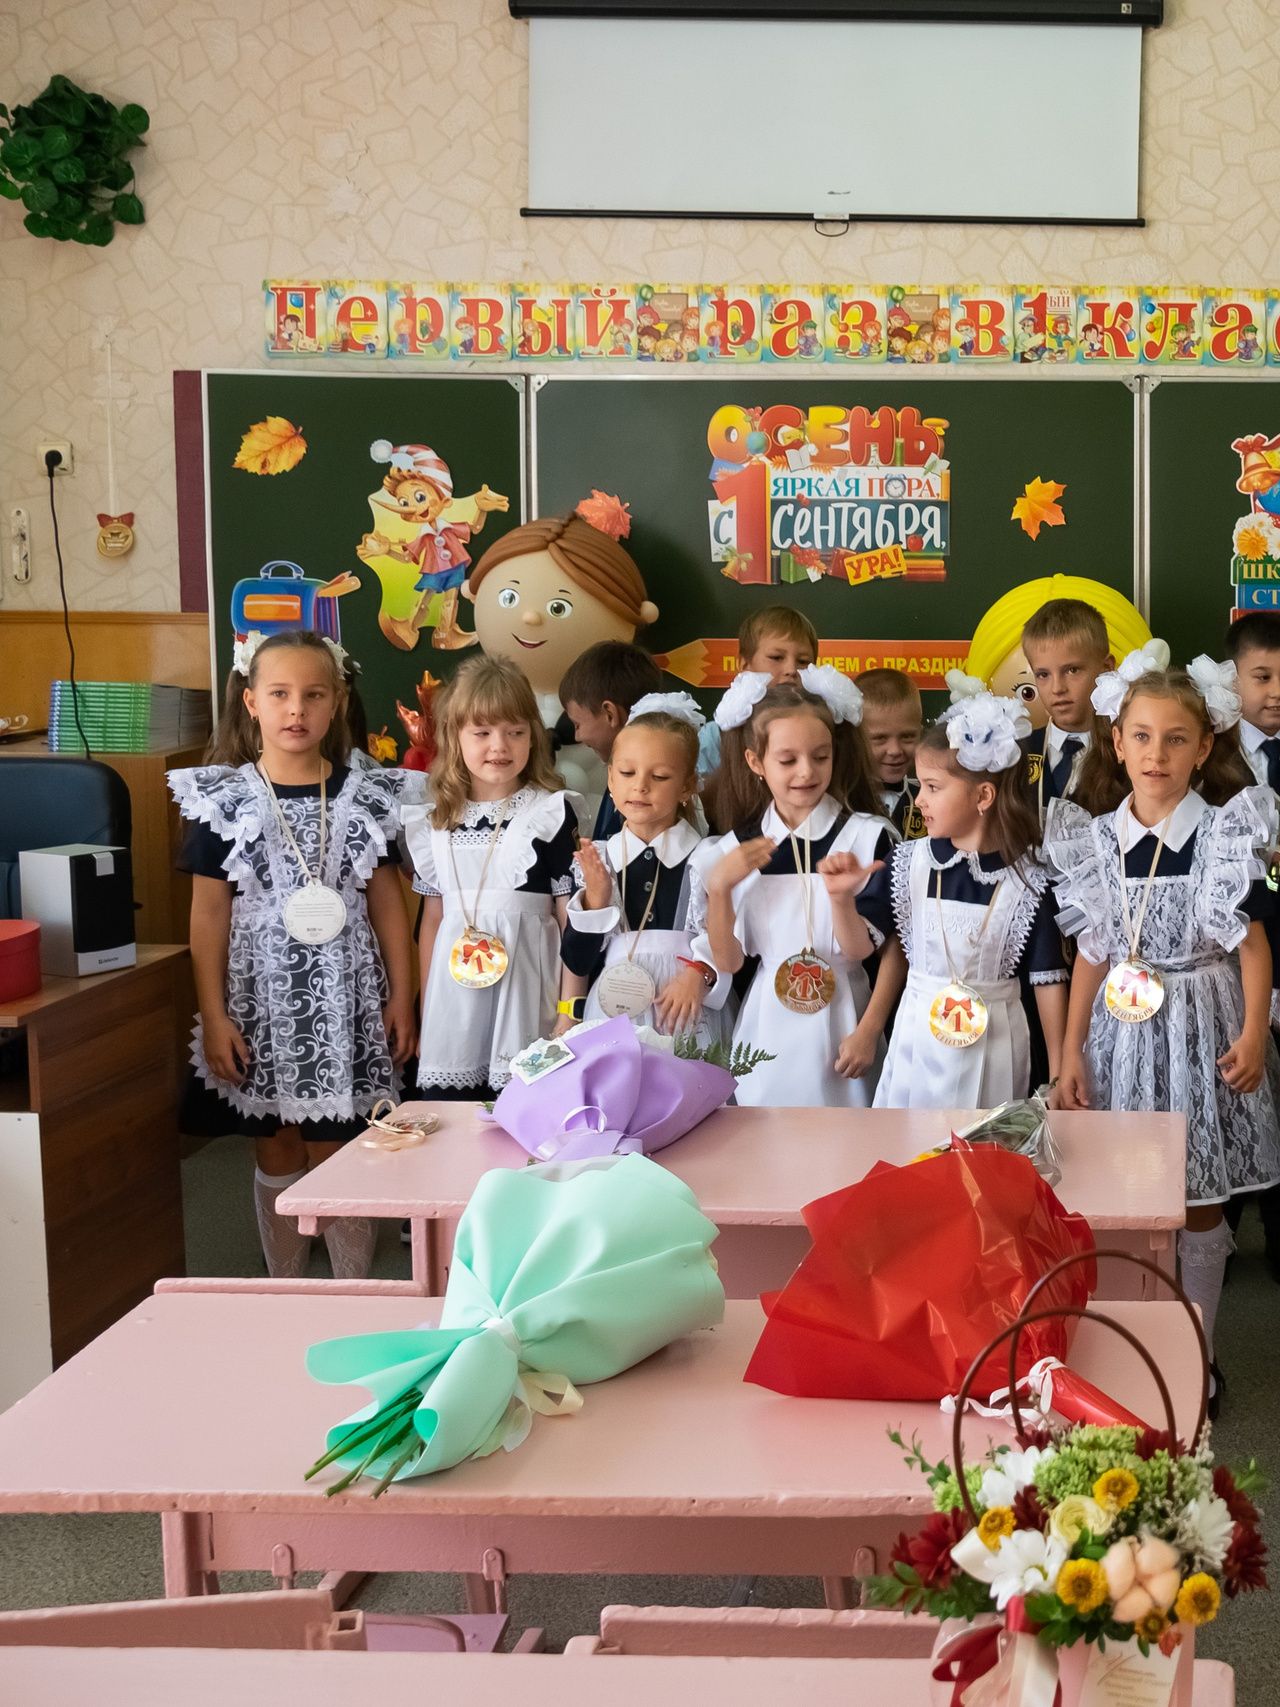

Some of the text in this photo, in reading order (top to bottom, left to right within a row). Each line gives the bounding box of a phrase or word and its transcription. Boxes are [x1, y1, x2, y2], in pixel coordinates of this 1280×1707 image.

[269, 287, 631, 356] Первый
[709, 299, 879, 357] раз
[707, 404, 946, 467] ОСЕНЬ
[770, 477, 860, 497] ЯРКАЯ
[847, 550, 902, 580] УРА!
[866, 657, 877, 670] С
[883, 657, 969, 676] ПРАЗДНИ
[911, 816, 921, 828] 16
